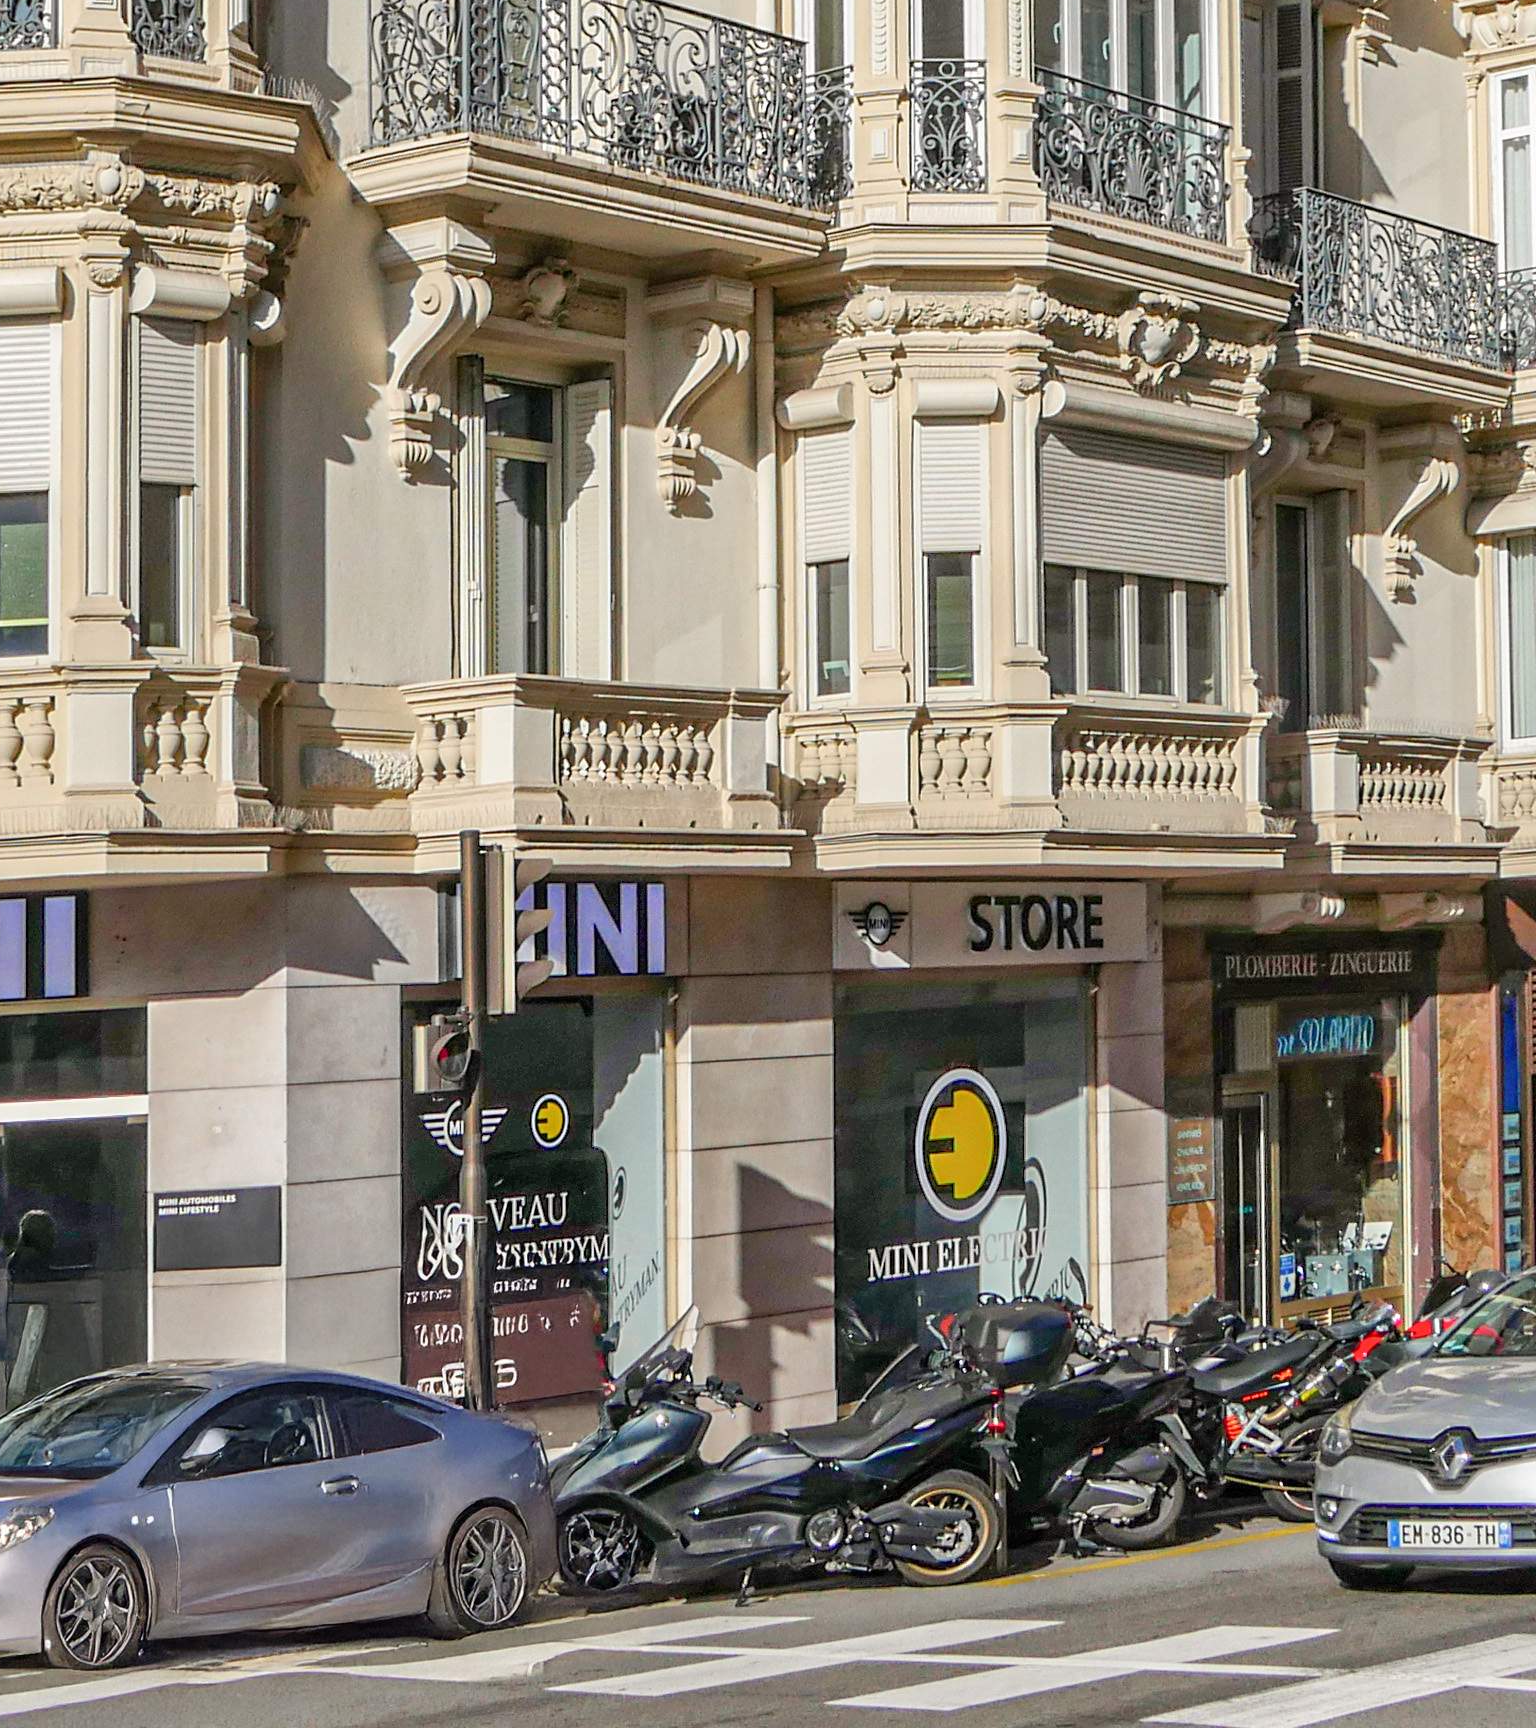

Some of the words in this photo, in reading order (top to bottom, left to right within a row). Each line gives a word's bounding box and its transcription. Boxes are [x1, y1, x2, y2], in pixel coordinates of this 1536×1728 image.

[515, 882, 665, 976] INI
[868, 917, 890, 930] MINI
[968, 894, 1104, 952] STORE
[1225, 953, 1318, 979] PLOMBERIE
[1329, 950, 1413, 976] ZINGUERIE
[178, 1194, 237, 1206] AUTOMOBILES
[178, 1204, 220, 1215] LIFESTYLE
[866, 1239, 931, 1283] MINI
[1401, 1524, 1497, 1545] EM-836-TH
